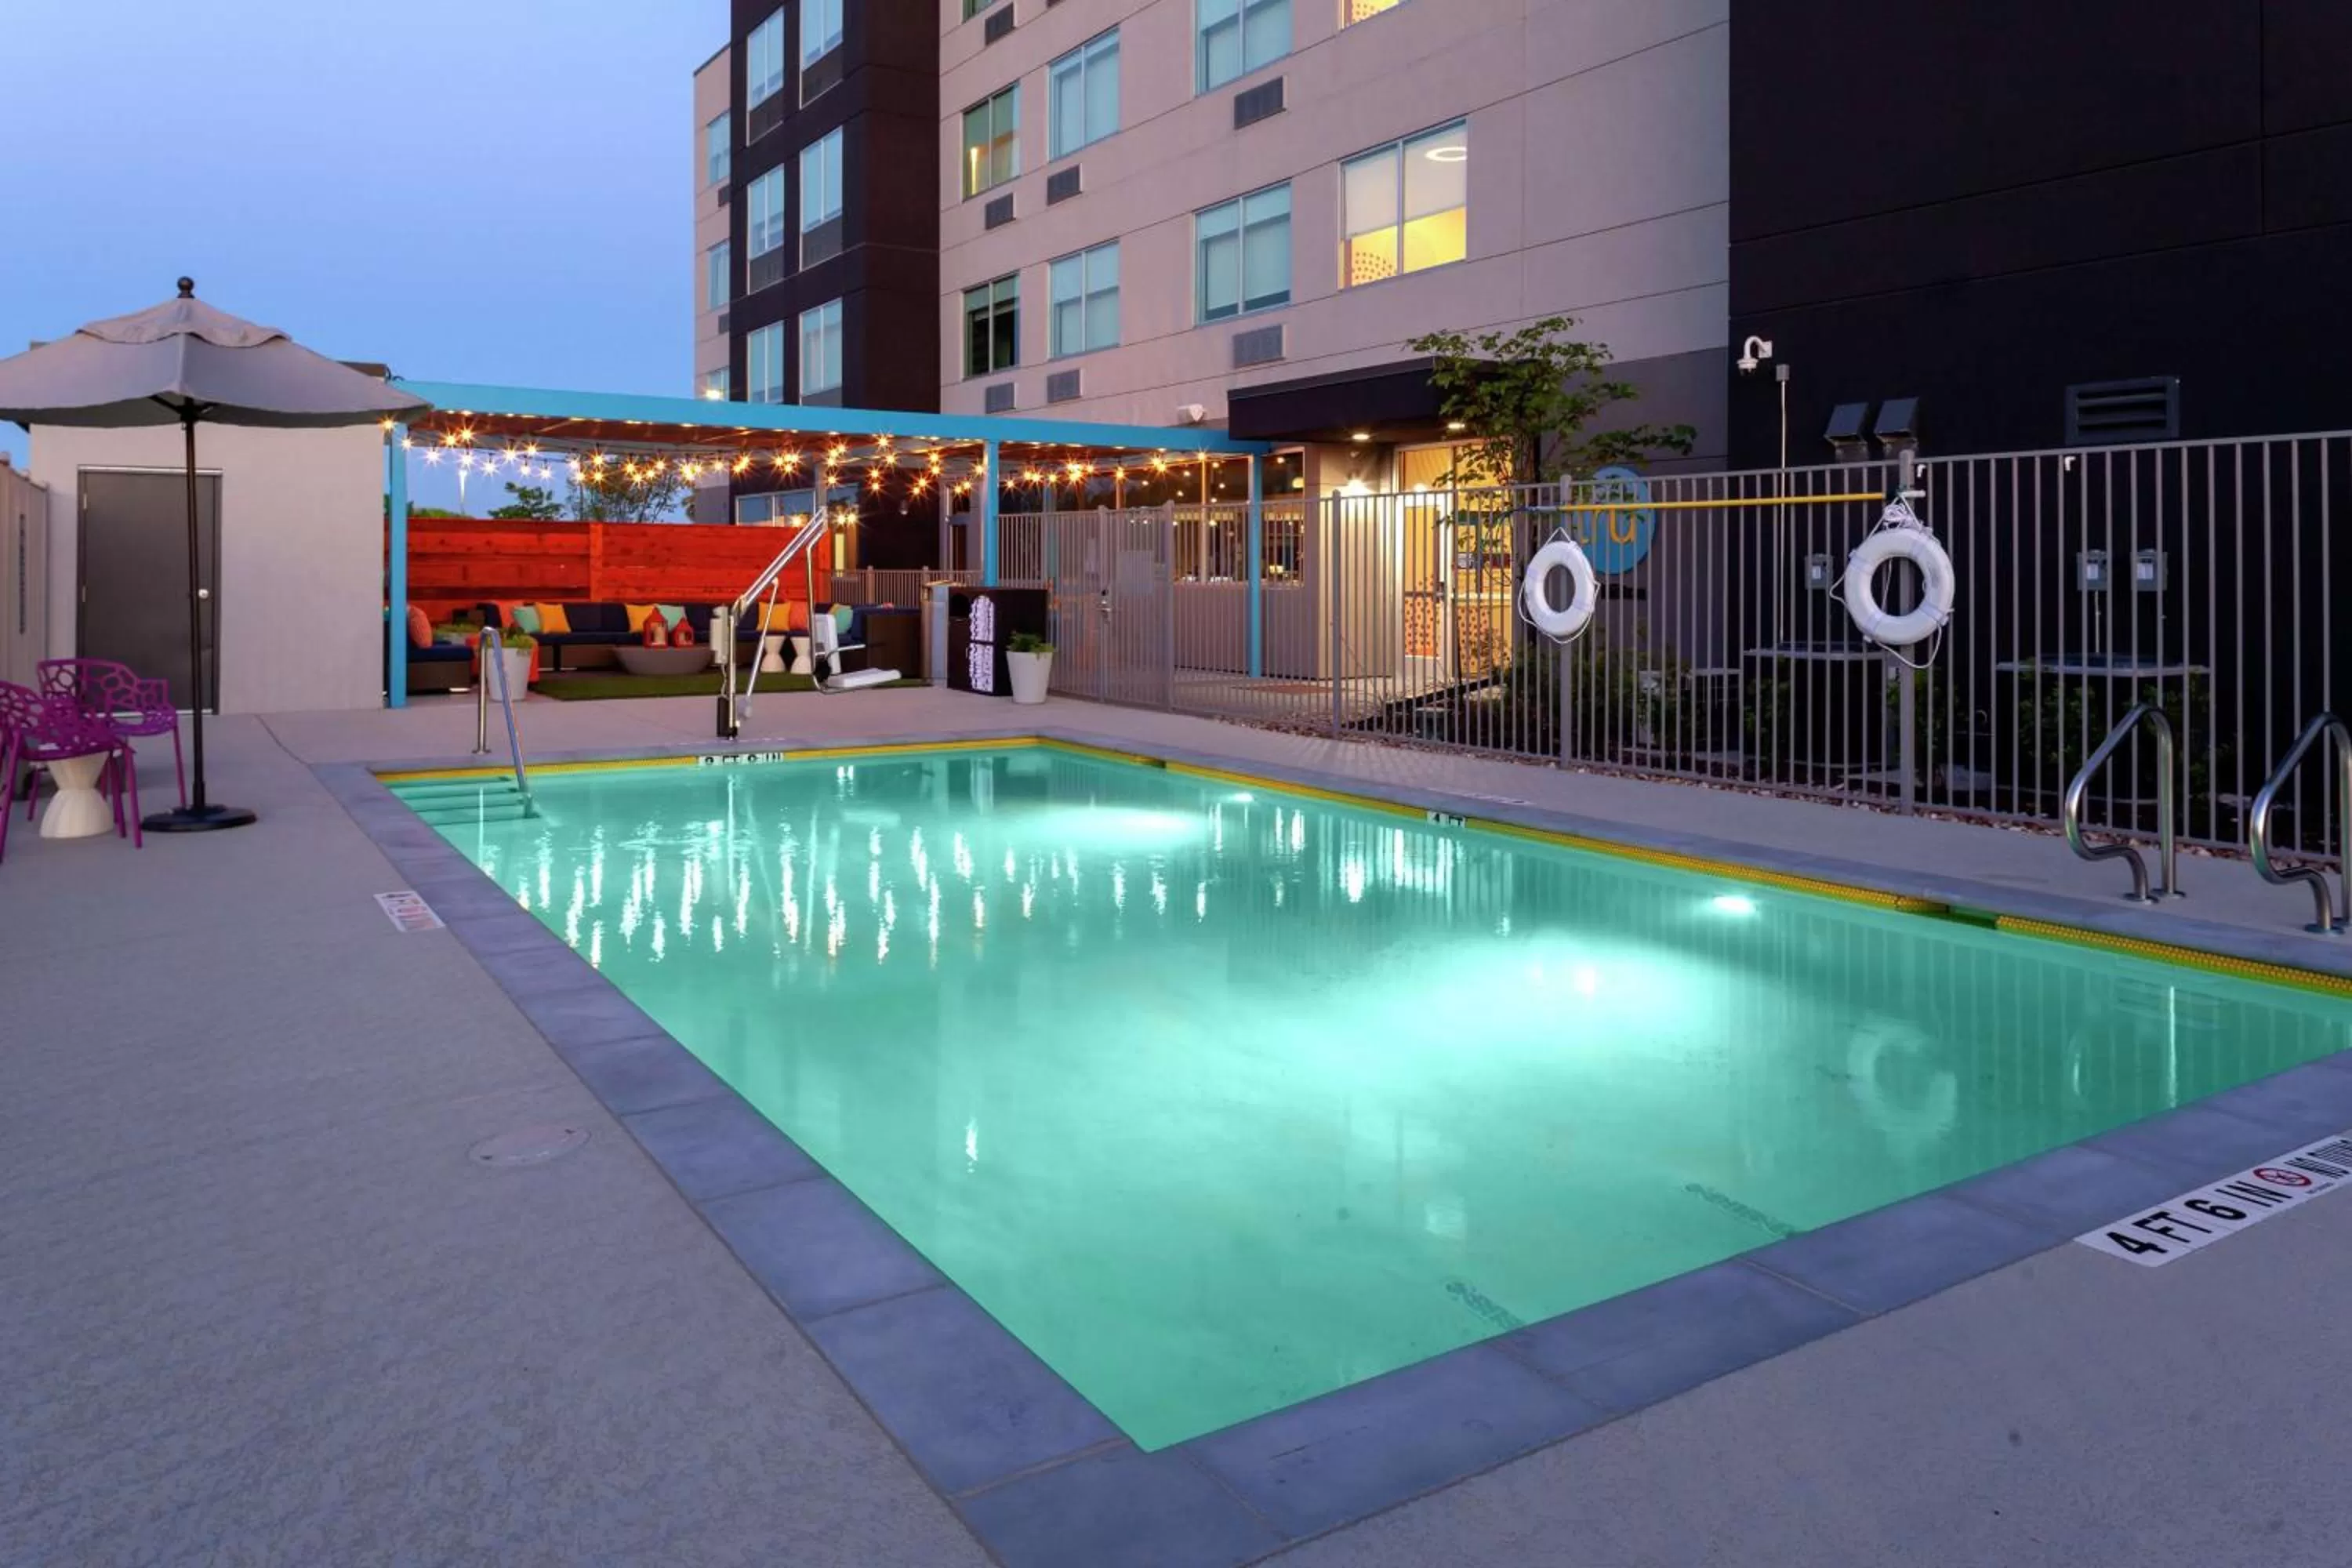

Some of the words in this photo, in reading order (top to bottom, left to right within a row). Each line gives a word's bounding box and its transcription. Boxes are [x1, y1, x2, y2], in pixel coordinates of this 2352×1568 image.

[2215, 1180, 2292, 1208] IN
[2184, 1199, 2247, 1221] 6
[2132, 1211, 2212, 1243] FT
[2105, 1231, 2168, 1255] 4
